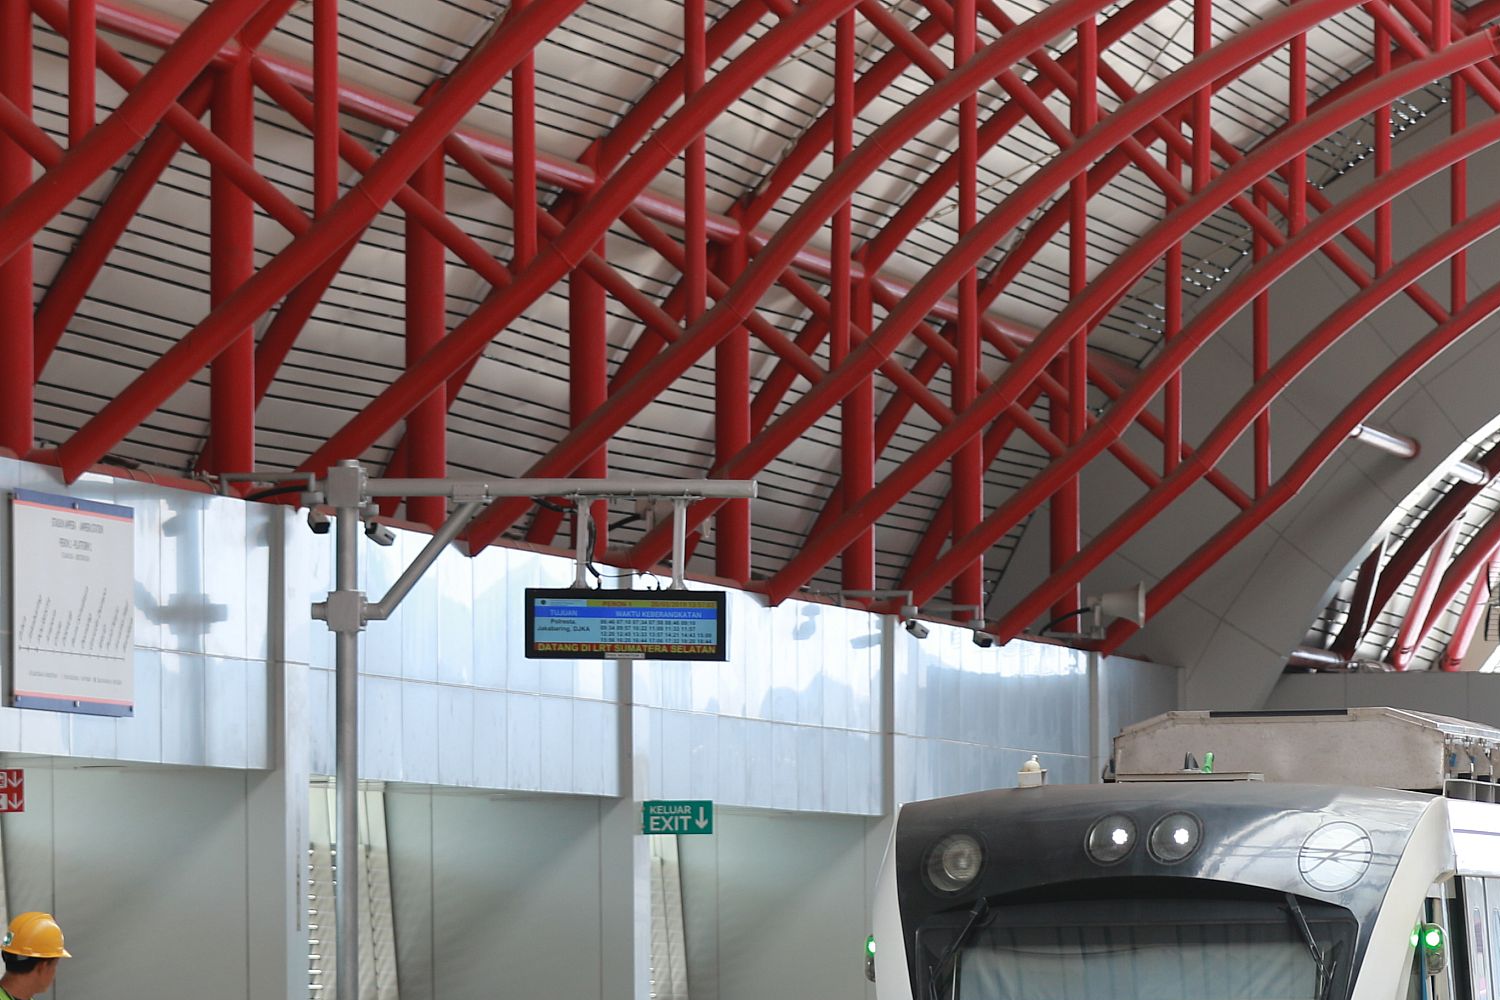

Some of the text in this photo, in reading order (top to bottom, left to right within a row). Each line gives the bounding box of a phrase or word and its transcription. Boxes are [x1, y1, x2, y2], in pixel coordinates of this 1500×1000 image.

[550, 609, 578, 617] TUJUAN
[537, 643, 716, 654] DATANG DI LRT SUMATERA SELATAN
[649, 805, 692, 814] KELUAR
[649, 815, 692, 831] EXIT
